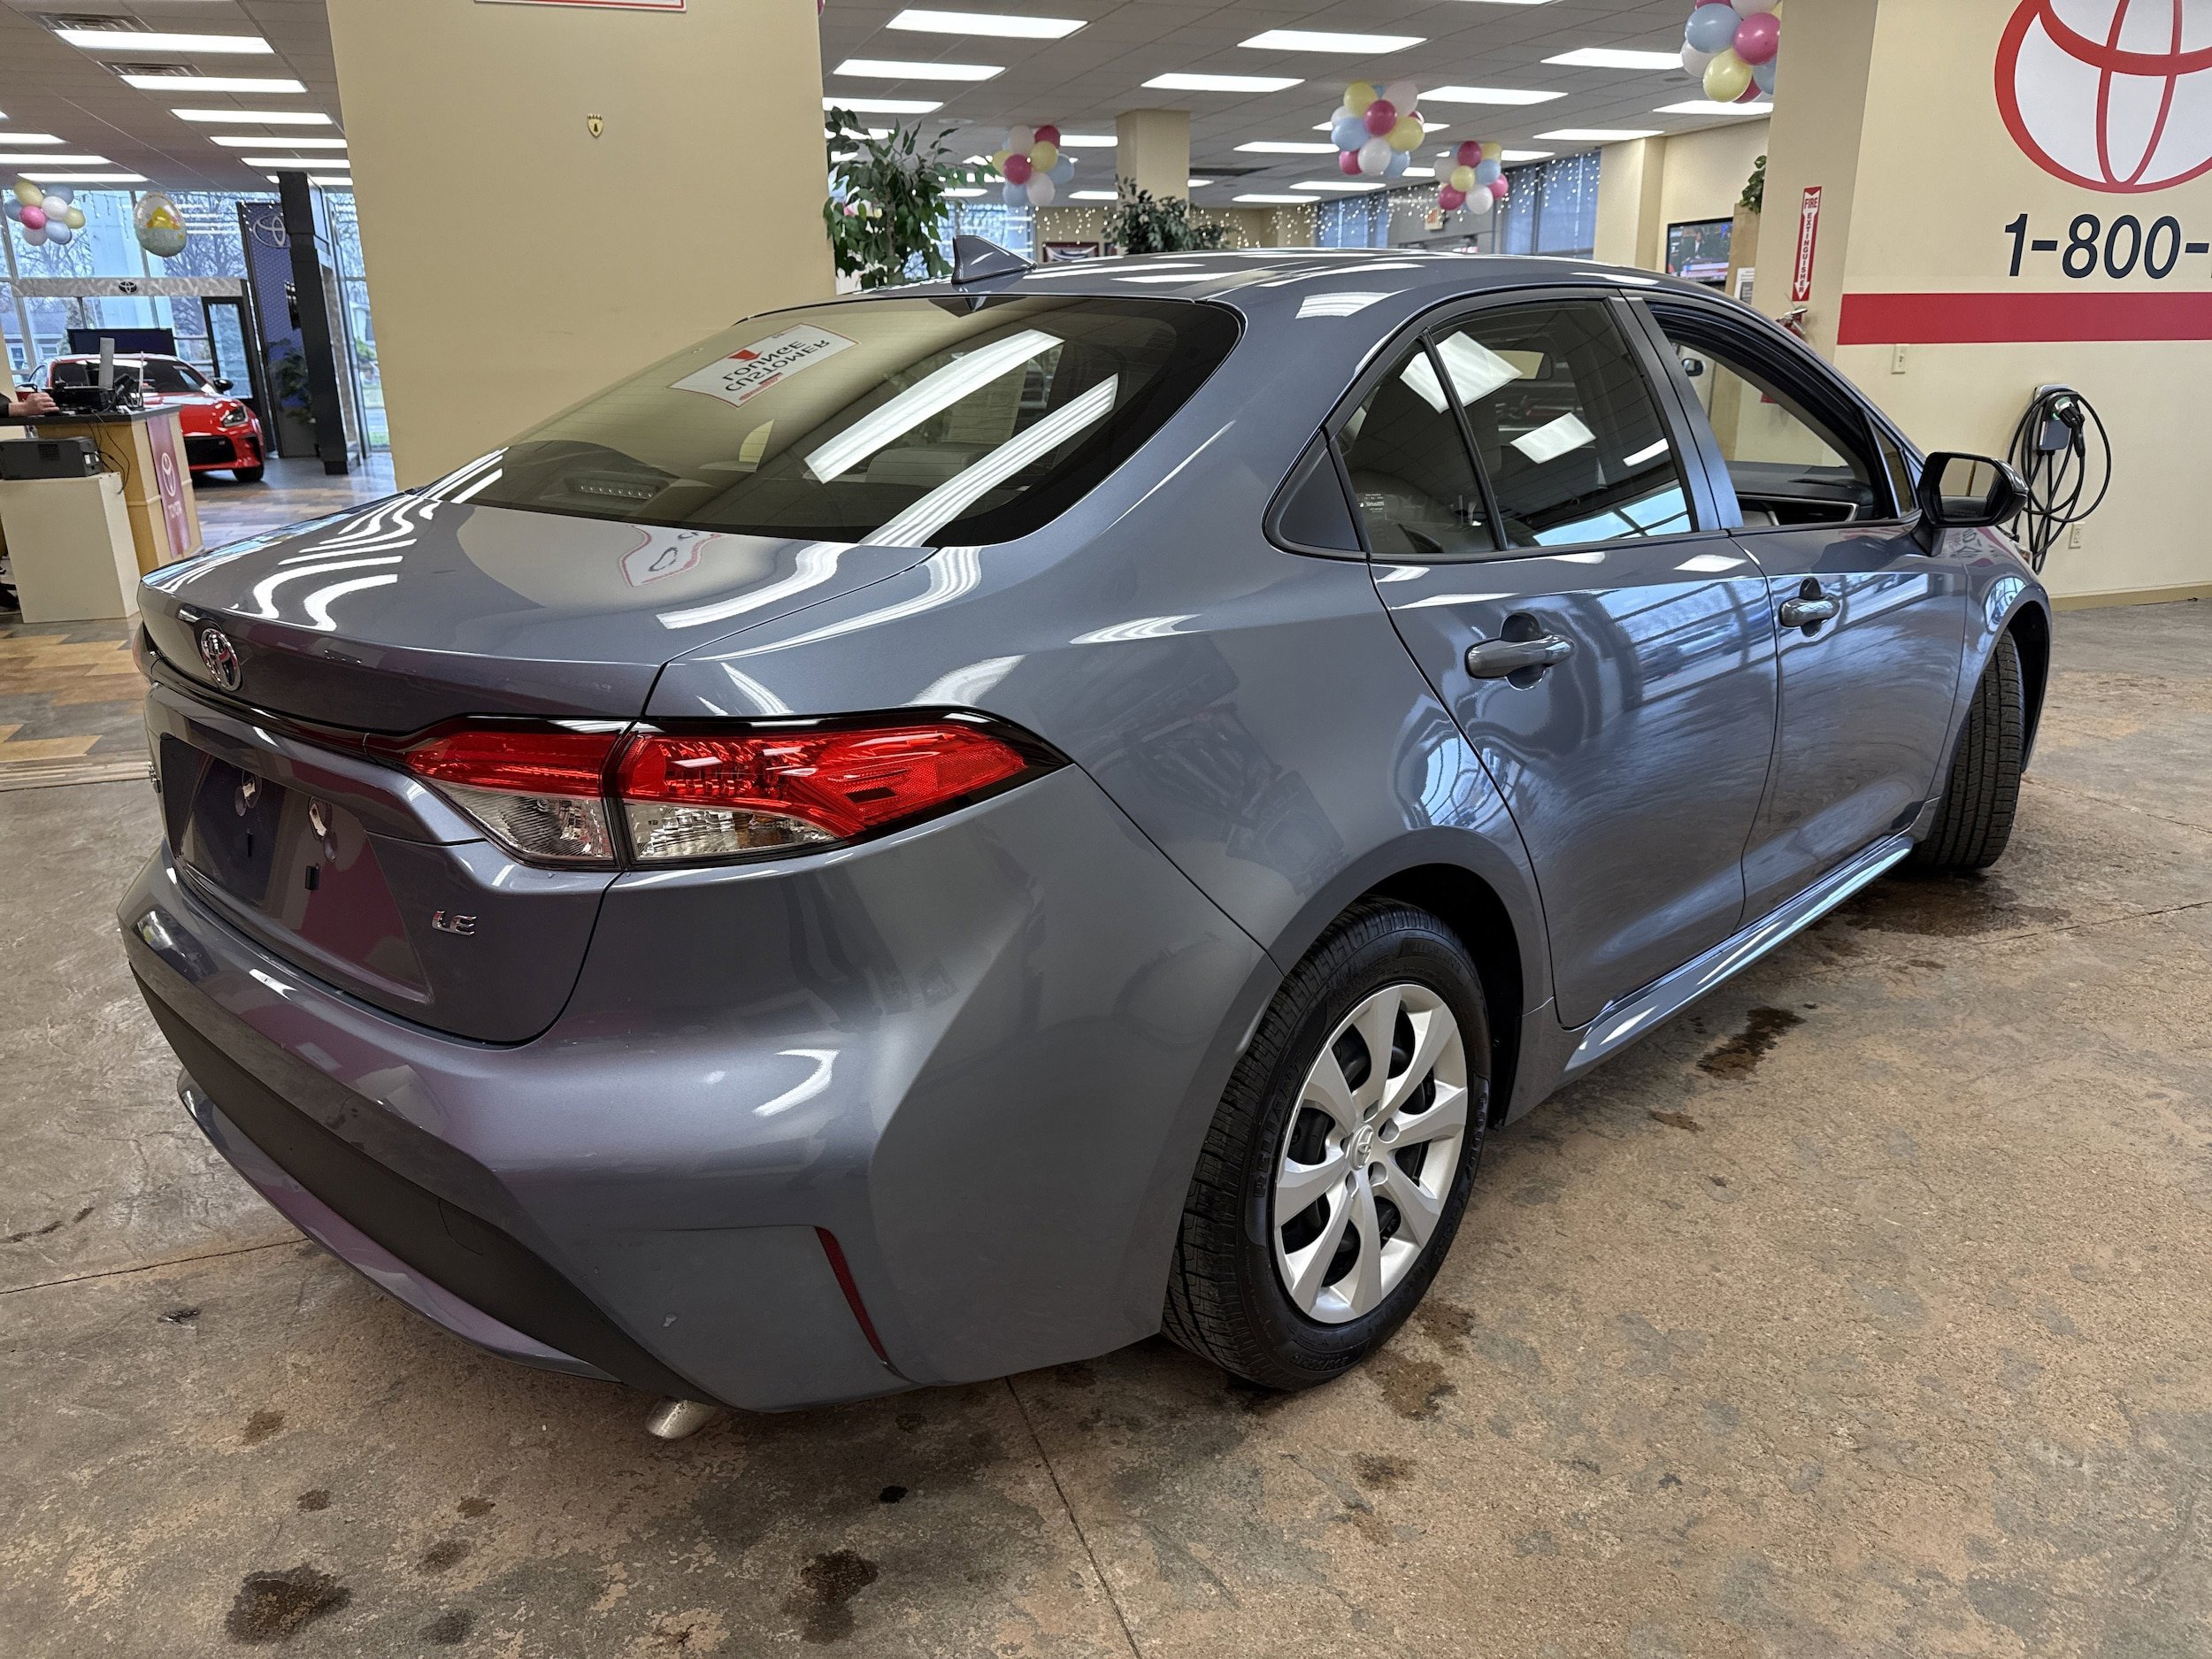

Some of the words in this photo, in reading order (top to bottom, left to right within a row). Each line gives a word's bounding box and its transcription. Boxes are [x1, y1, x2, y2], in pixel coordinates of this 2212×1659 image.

[1804, 197, 1817, 209] FIRE
[1799, 213, 1812, 292] EXTINGUISHER
[431, 910, 478, 936] LE
[1254, 1048, 1304, 1198] RELIANT
